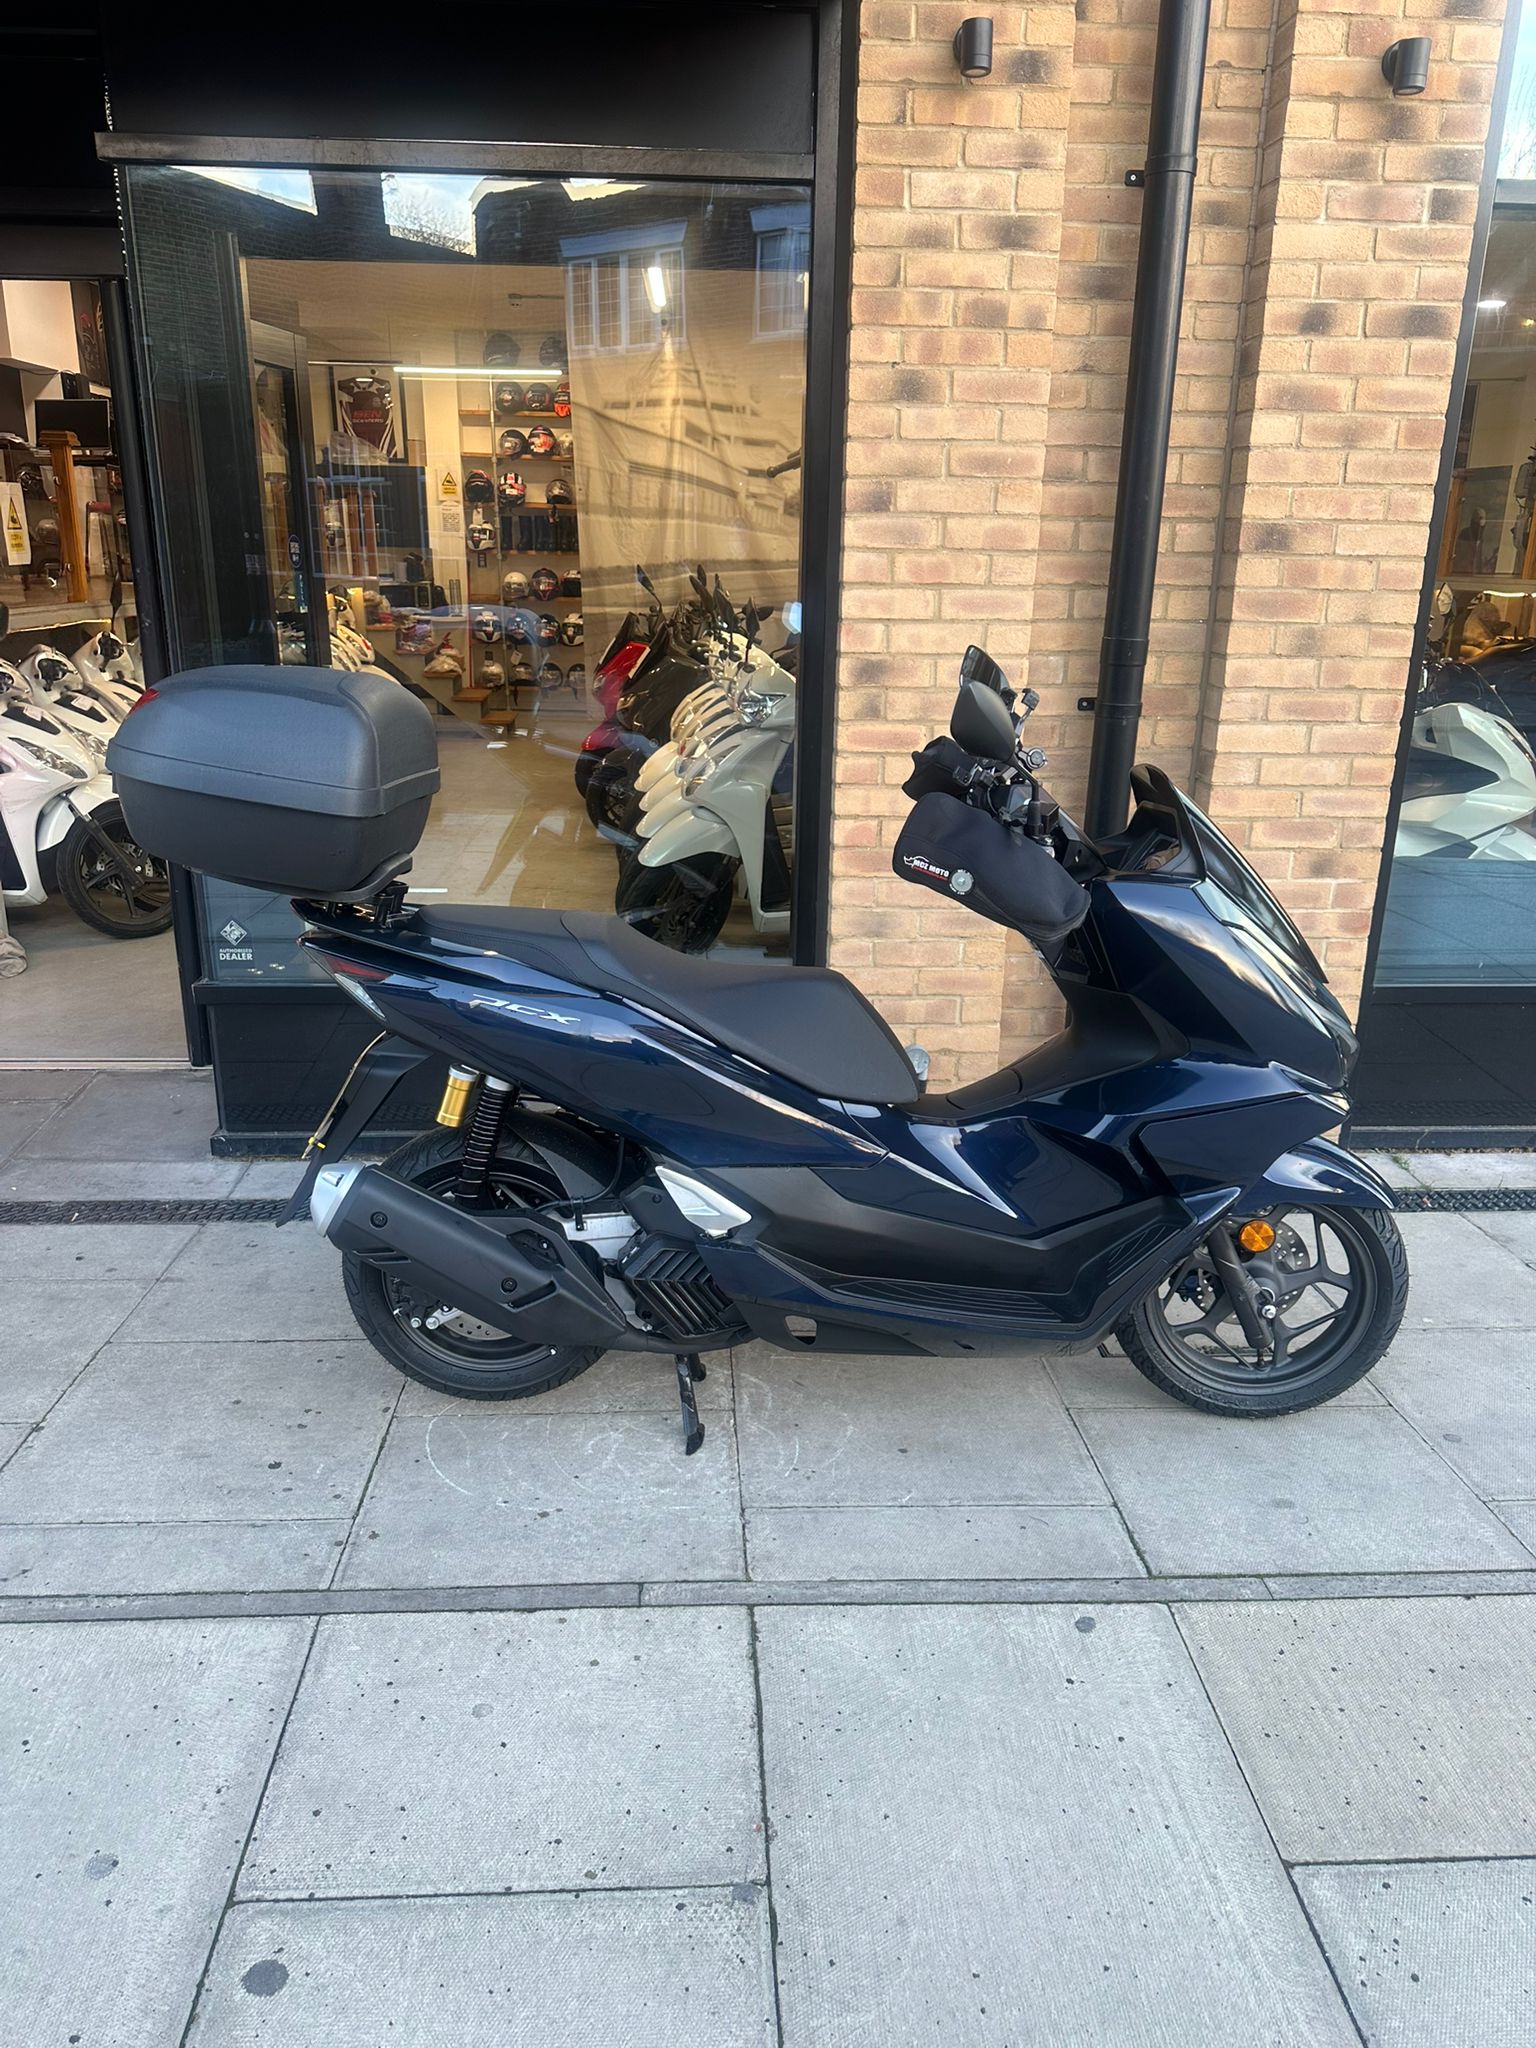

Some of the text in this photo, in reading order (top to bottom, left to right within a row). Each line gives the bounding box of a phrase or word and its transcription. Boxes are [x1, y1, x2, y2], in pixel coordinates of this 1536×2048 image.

[929, 865, 950, 878] MOTO
[219, 952, 253, 961] DEALER
[468, 993, 581, 1025] PCX
